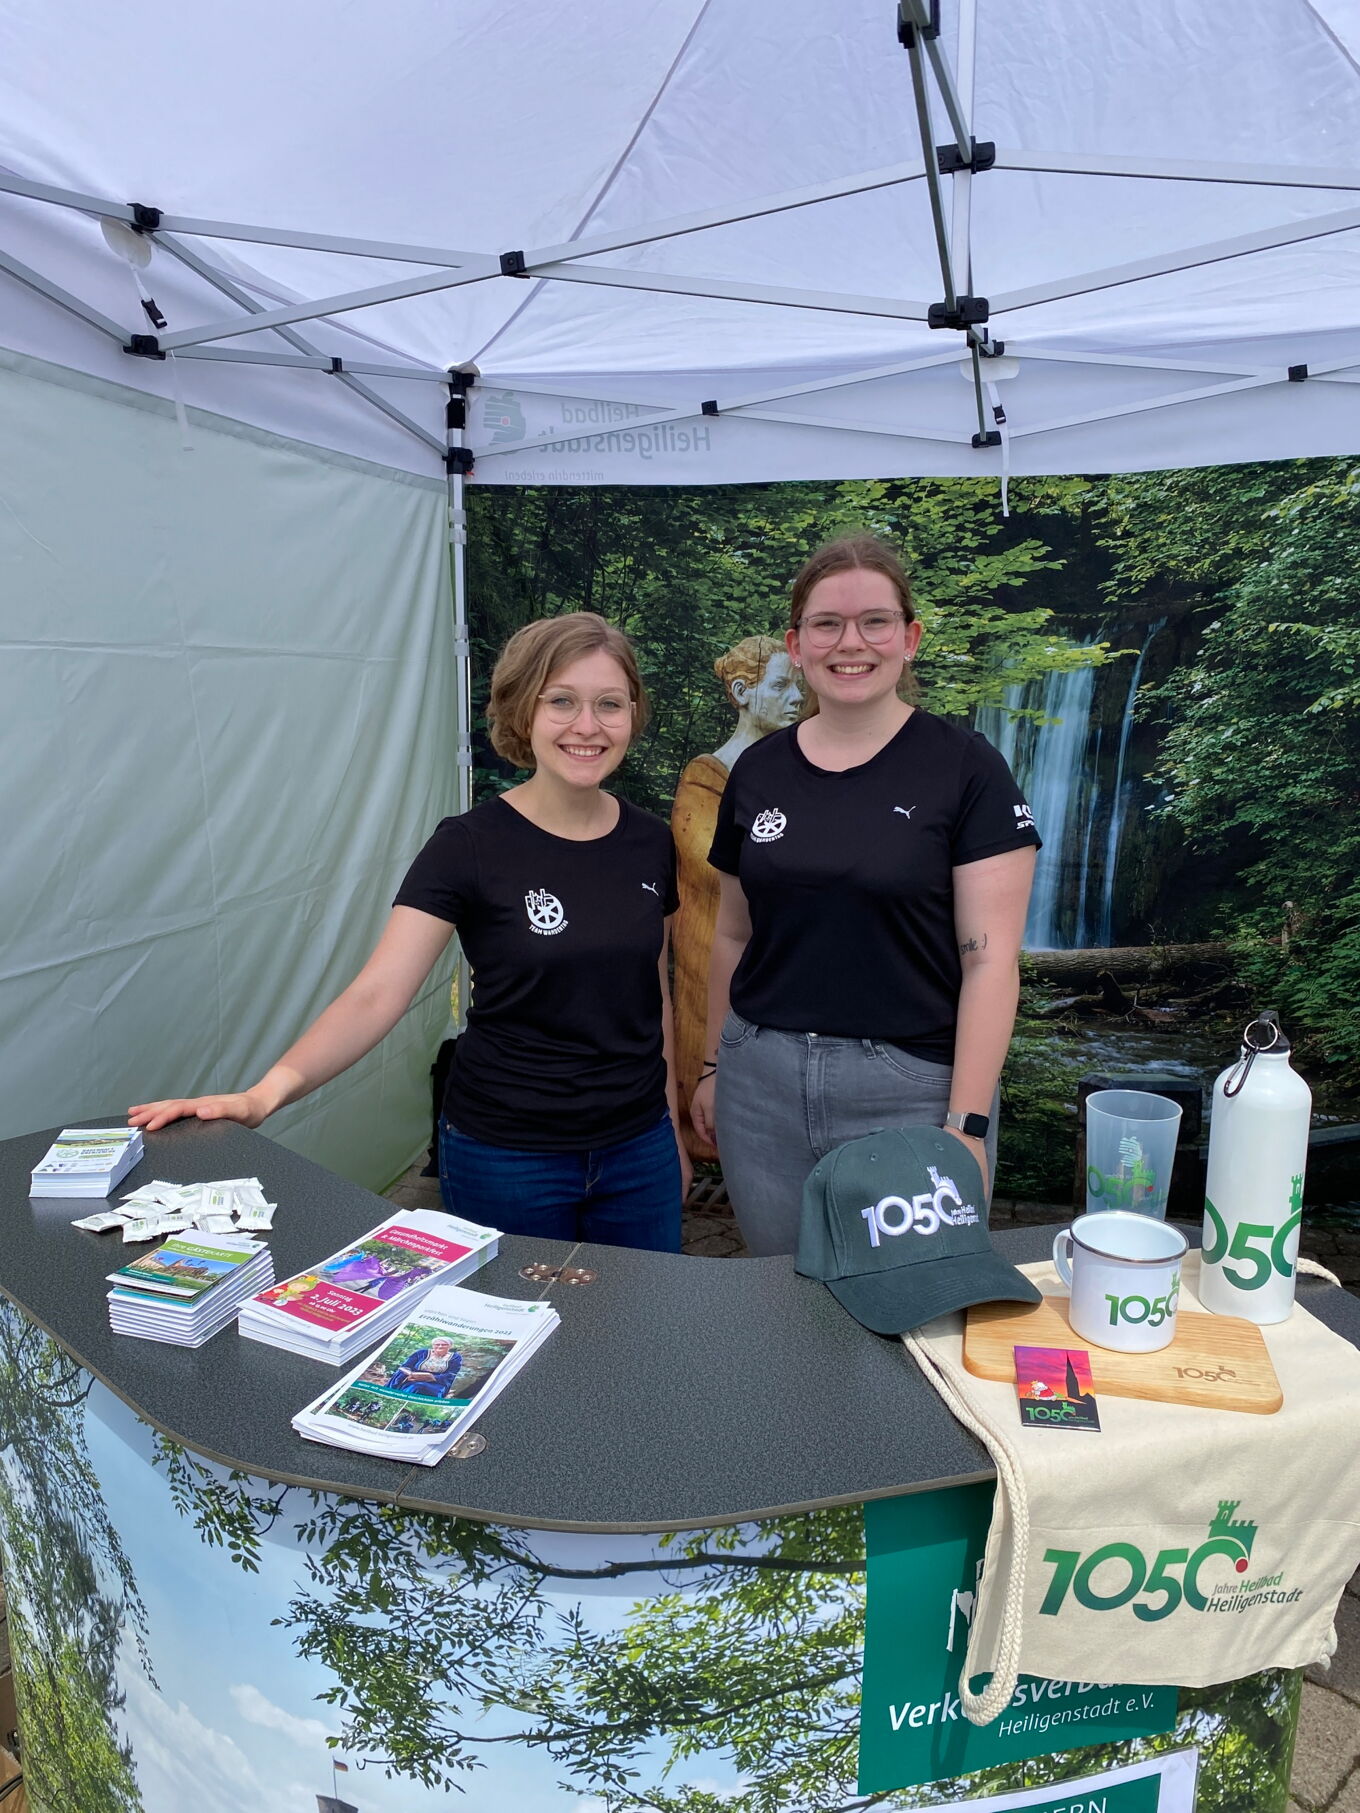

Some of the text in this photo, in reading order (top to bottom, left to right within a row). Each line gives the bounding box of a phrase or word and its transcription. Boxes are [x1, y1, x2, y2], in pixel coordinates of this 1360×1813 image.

[861, 1187, 962, 1248] 1050
[317, 1296, 342, 1307] Juli
[337, 1303, 363, 1316] 2023
[327, 1290, 353, 1303] Sonntag
[1105, 1287, 1180, 1328] 1050
[418, 1314, 494, 1334] Erzählwanderungen
[1172, 1367, 1236, 1382] 1050
[1026, 1407, 1076, 1422] 1050
[1039, 1538, 1249, 1622] 1050
[1212, 1572, 1284, 1596] Jahre Heilbad
[1207, 1588, 1303, 1614] Heiligenstadt
[998, 1692, 1155, 1738] Heiligenstadt e.V.
